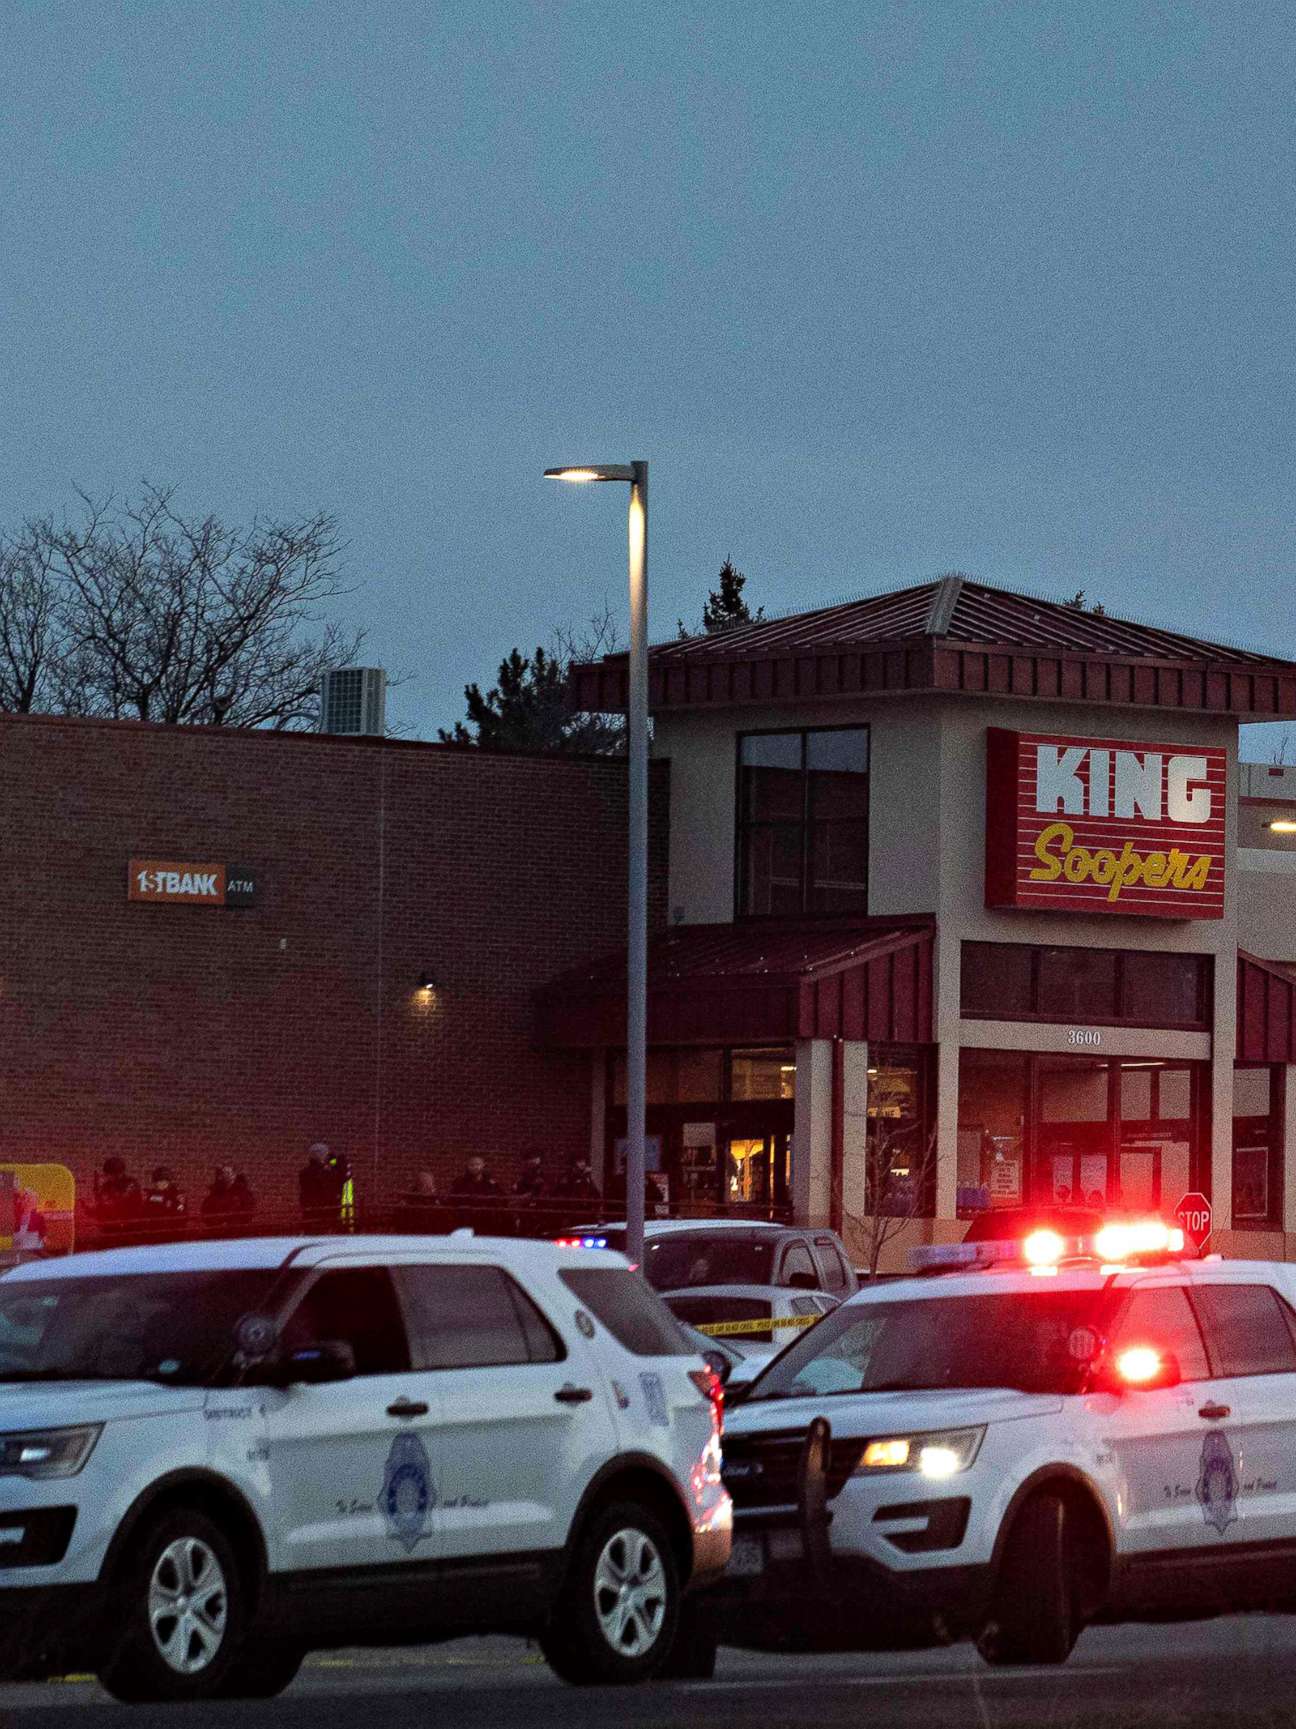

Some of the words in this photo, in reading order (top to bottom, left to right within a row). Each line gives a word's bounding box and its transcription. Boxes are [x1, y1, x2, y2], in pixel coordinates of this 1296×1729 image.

[1036, 745, 1211, 823] KING
[1029, 822, 1212, 903] Soopers
[227, 880, 254, 893] ATM
[1068, 1030, 1101, 1045] 3600
[1178, 1211, 1210, 1231] STOP
